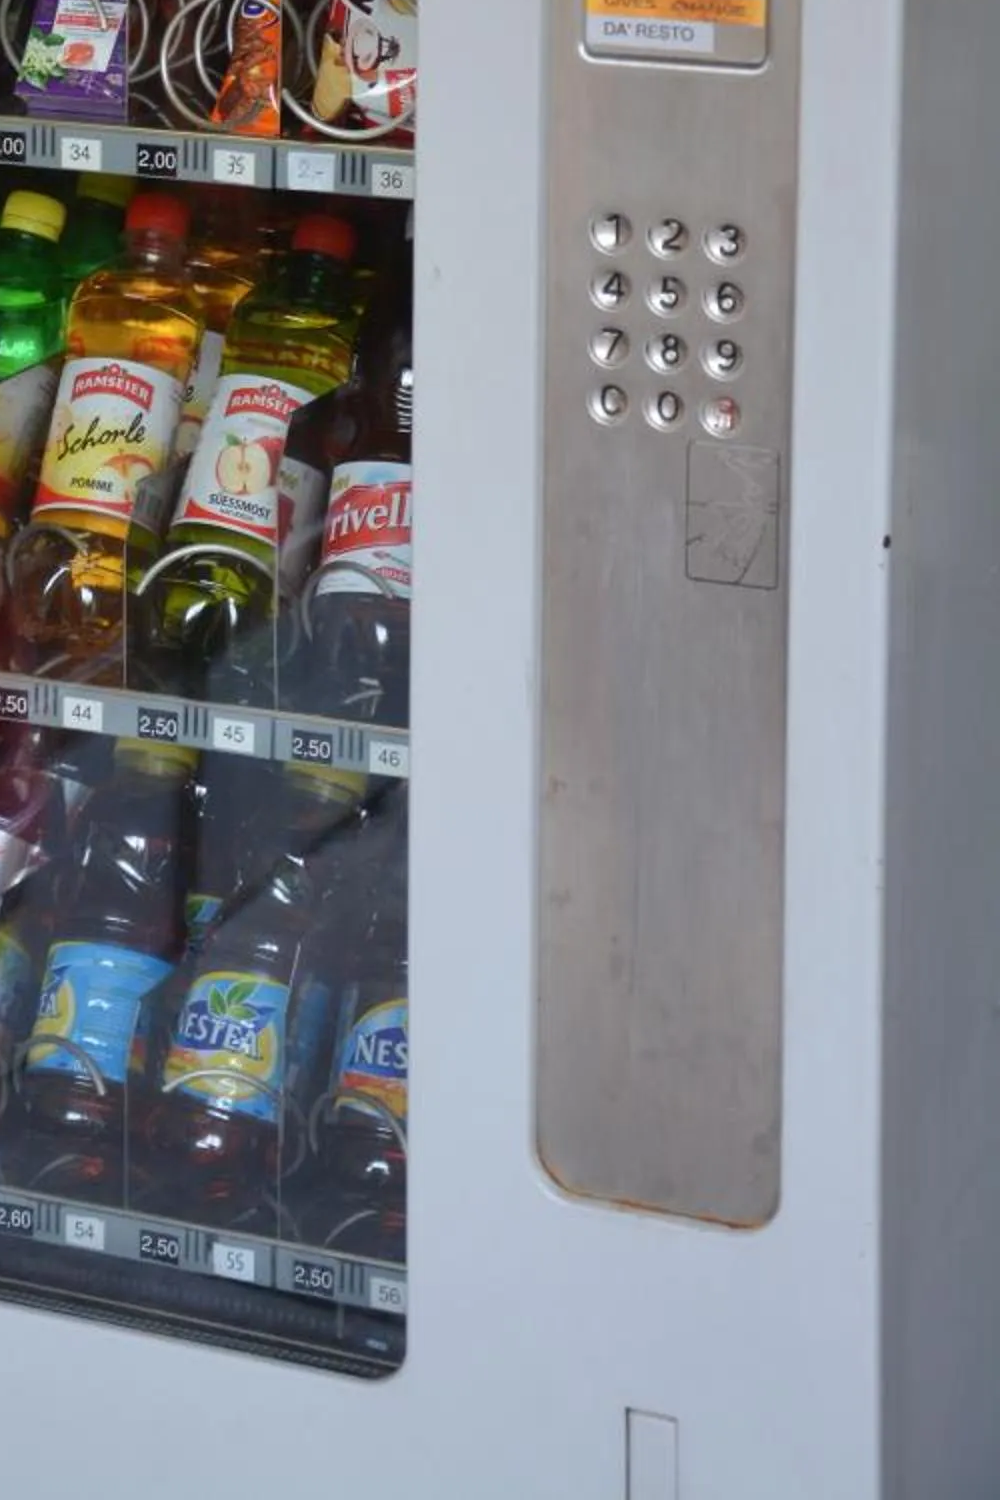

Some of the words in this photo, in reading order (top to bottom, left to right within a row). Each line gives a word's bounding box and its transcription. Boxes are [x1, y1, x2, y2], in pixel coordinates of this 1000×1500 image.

[635, 24, 696, 42] RESTO
[70, 144, 90, 161] 34
[227, 155, 246, 174] 35
[381, 171, 403, 189] 36
[607, 213, 622, 246] 1
[661, 218, 684, 251] 2
[719, 224, 740, 257] 3
[602, 272, 625, 304] 4
[659, 276, 679, 310] 5
[717, 281, 739, 314] 6
[601, 328, 625, 360] 7
[661, 333, 680, 366] 8
[717, 339, 738, 372] 9
[74, 373, 151, 402] RAMSEIER
[601, 384, 625, 417] C
[657, 391, 680, 422] 0
[56, 411, 147, 461] Schorle
[69, 476, 114, 493] POMME
[71, 704, 93, 721] 44
[223, 725, 246, 744] 45
[378, 749, 401, 768] 46
[74, 1221, 96, 1241] 54
[226, 1252, 246, 1272] 55
[379, 1285, 402, 1305] 56
